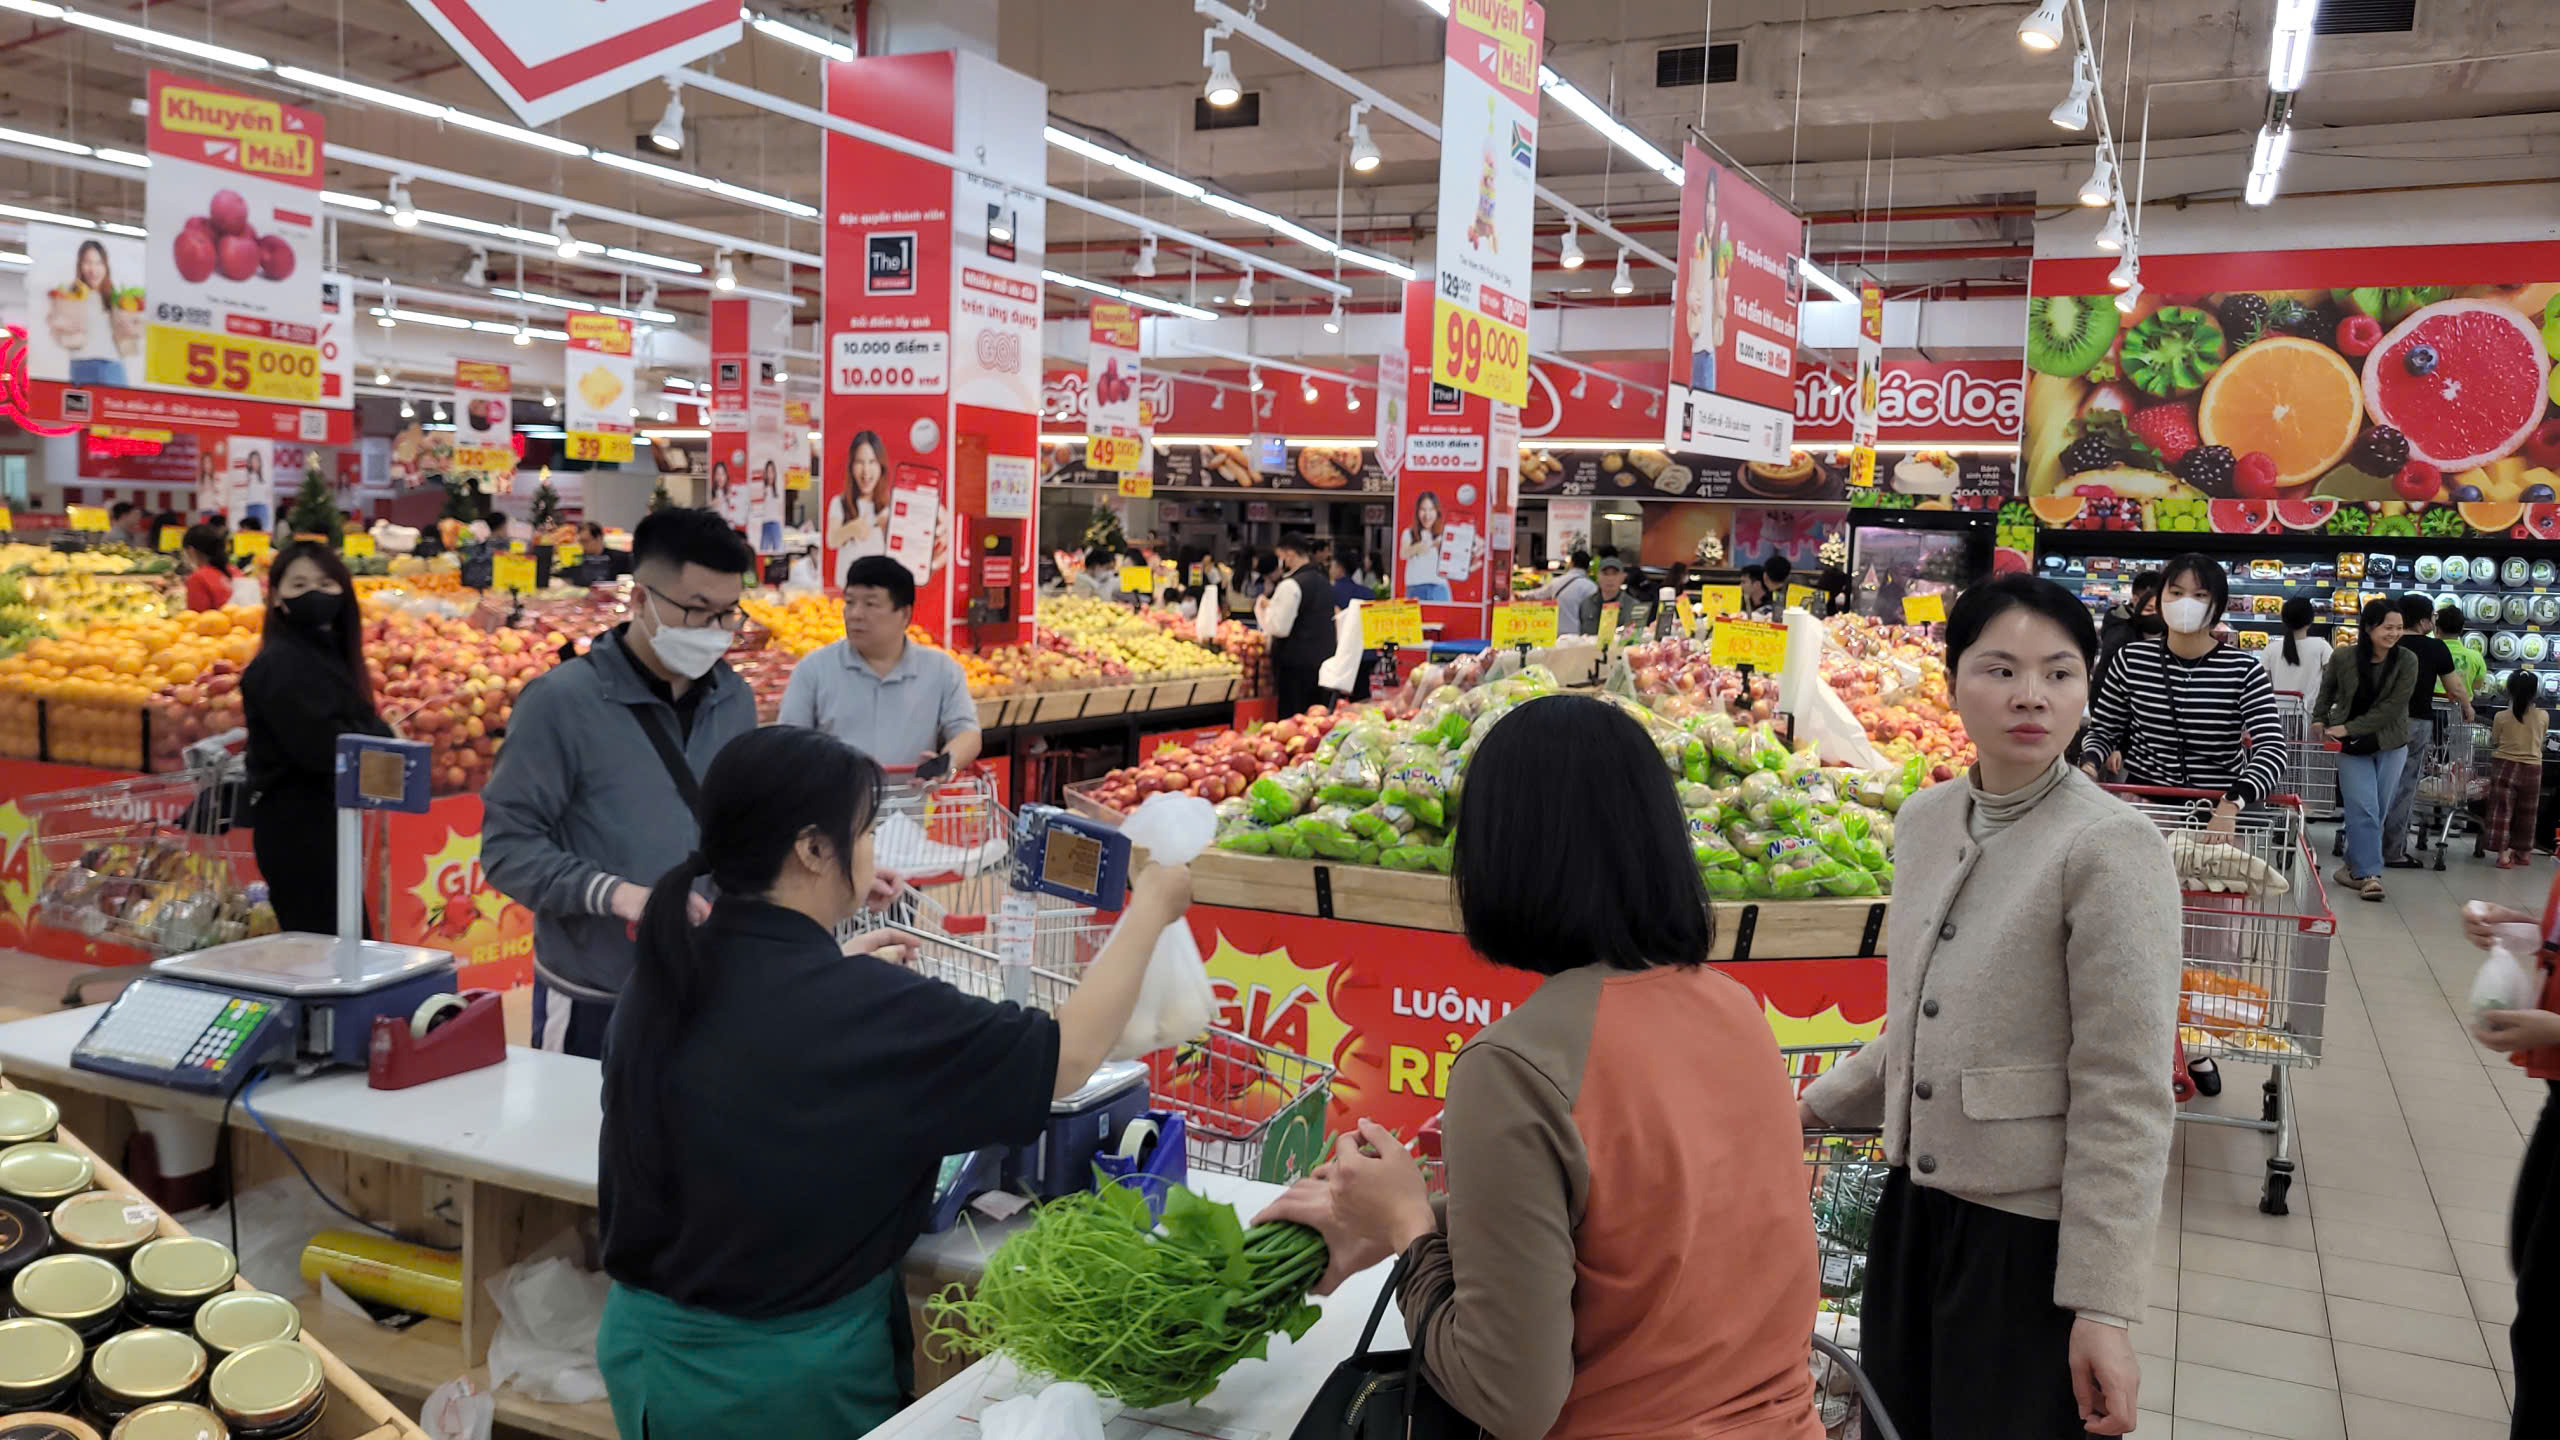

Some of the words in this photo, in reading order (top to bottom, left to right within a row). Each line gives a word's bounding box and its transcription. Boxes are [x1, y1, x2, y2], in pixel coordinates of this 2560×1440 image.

[167, 97, 273, 133] Khuyến
[842, 368, 913, 385] 10.000
[1393, 986, 1490, 1026] LUÔN
